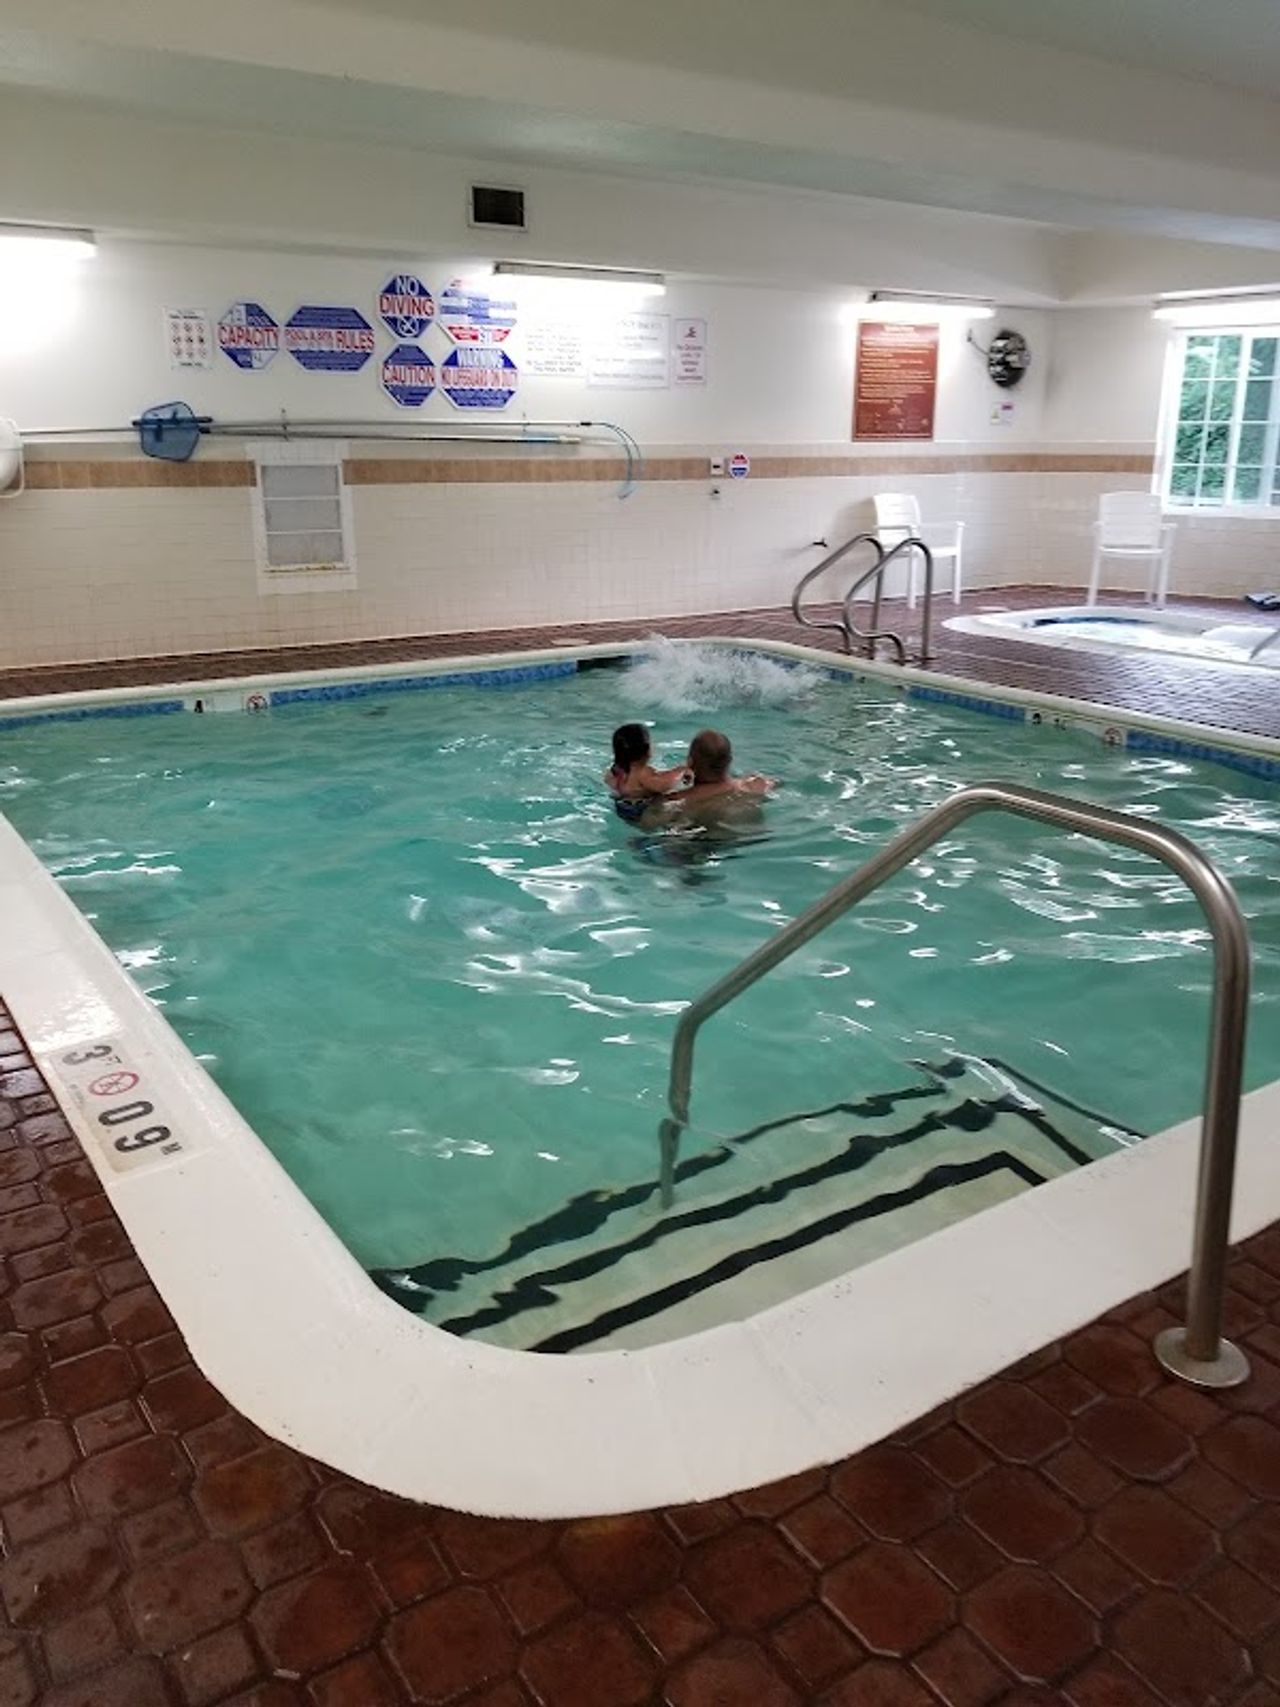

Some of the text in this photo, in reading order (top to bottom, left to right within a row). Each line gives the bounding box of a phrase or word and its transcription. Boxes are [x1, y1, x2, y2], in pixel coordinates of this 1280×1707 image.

[396, 275, 419, 295] NO
[379, 295, 434, 316] DIVING
[218, 326, 279, 349] CAPACITY
[335, 329, 374, 351] RULES
[382, 365, 434, 384] CAUTION
[62, 1045, 112, 1065] 3
